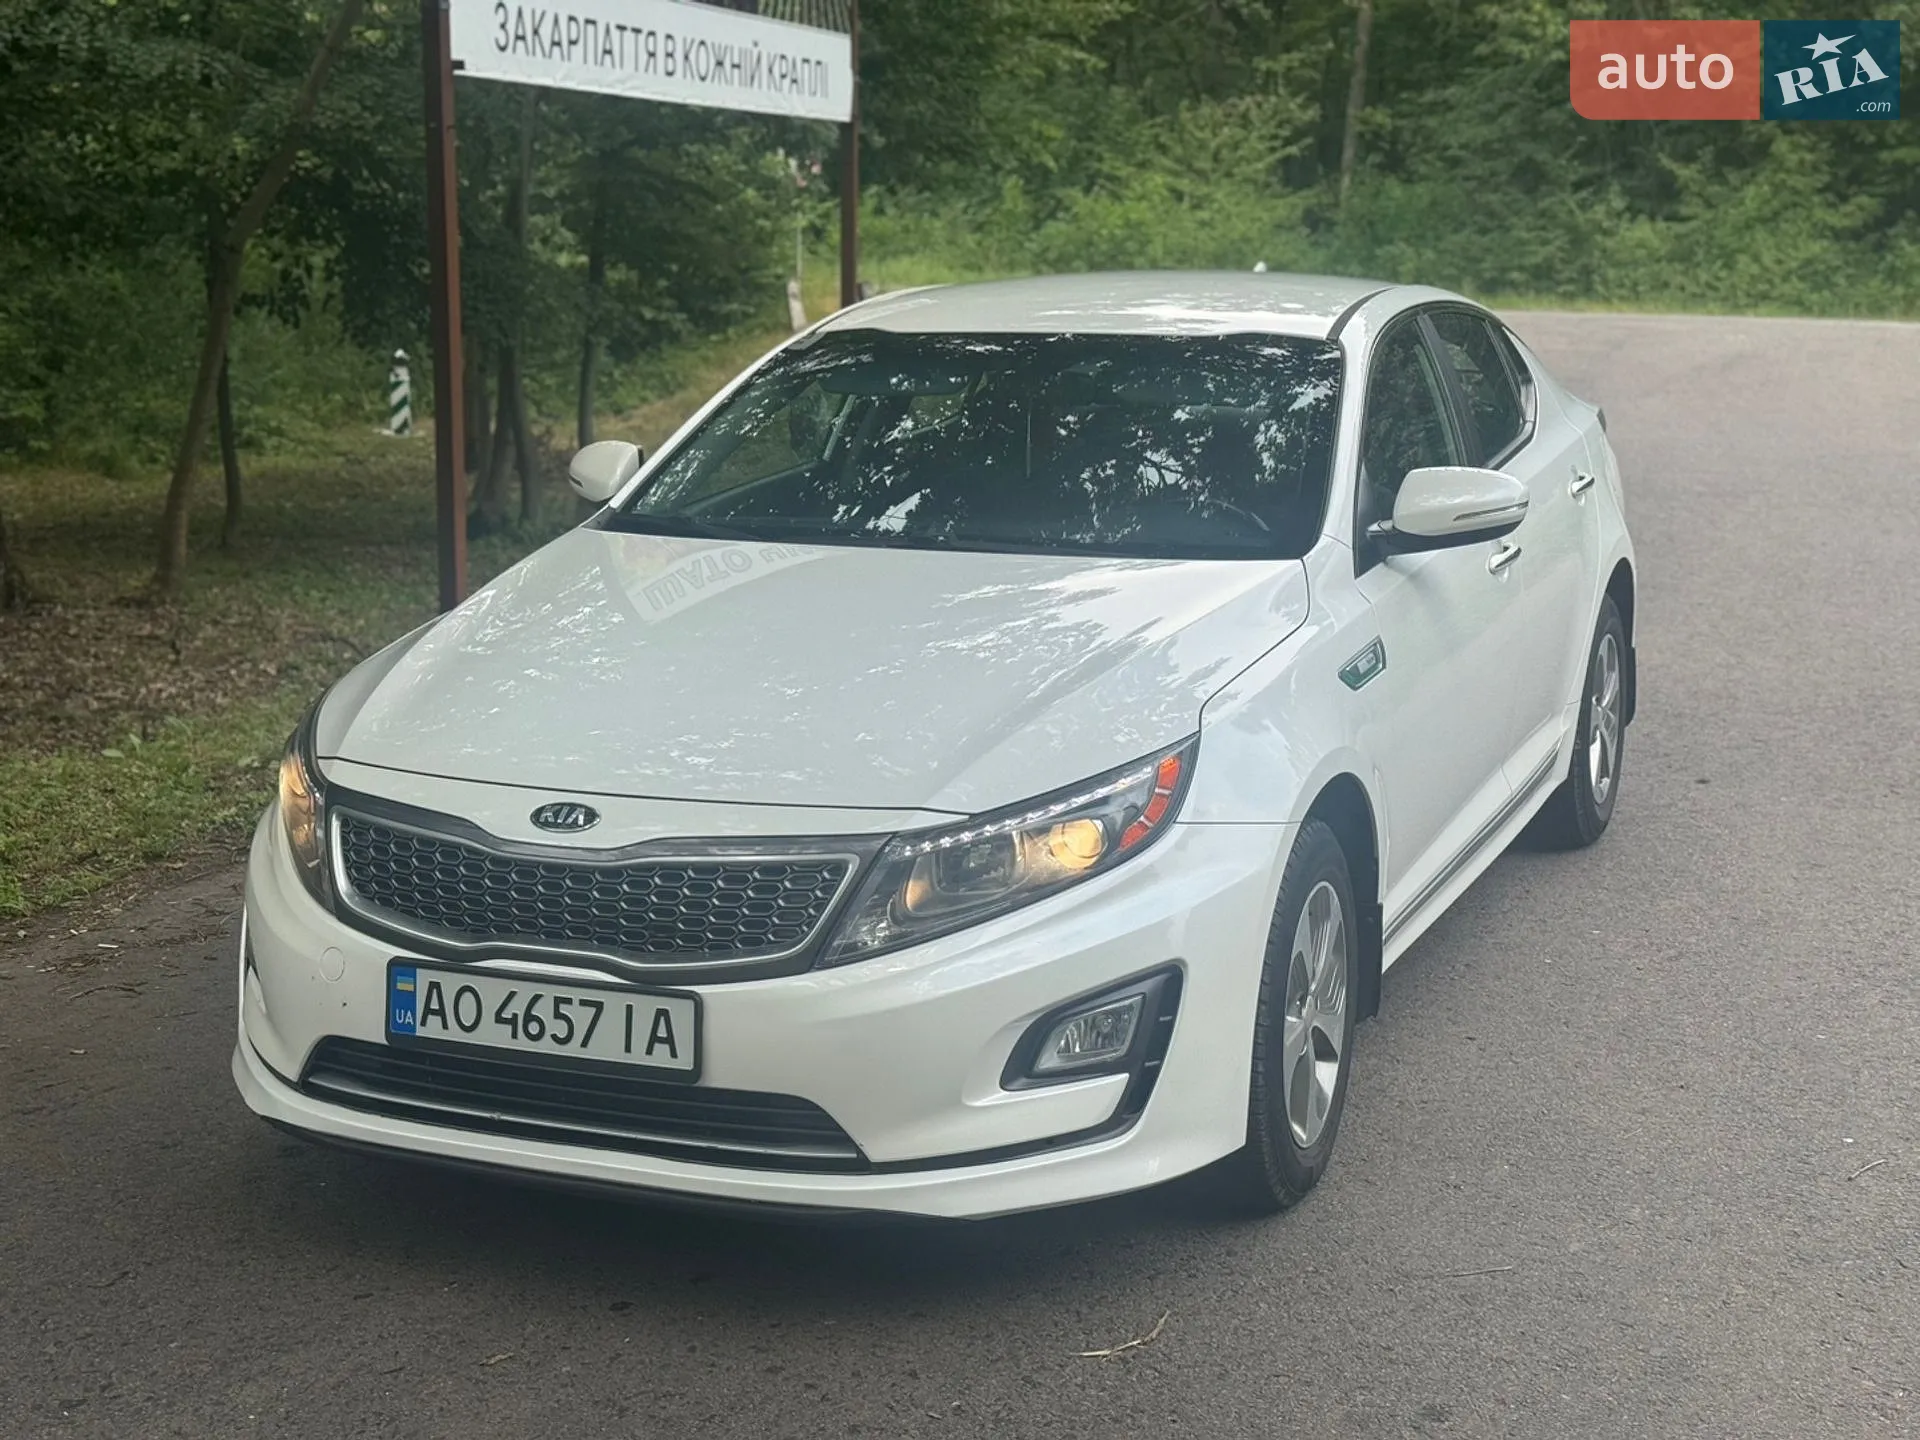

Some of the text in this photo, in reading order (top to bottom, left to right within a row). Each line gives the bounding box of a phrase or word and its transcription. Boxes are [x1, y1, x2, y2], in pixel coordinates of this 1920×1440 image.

[493, 3, 829, 98] ЗАКАРПАТТЯ В КОЖНІЙ КРАПЛІ
[538, 805, 586, 828] KIA
[395, 1009, 414, 1026] UA
[420, 980, 679, 1059] AO 4657 IA
